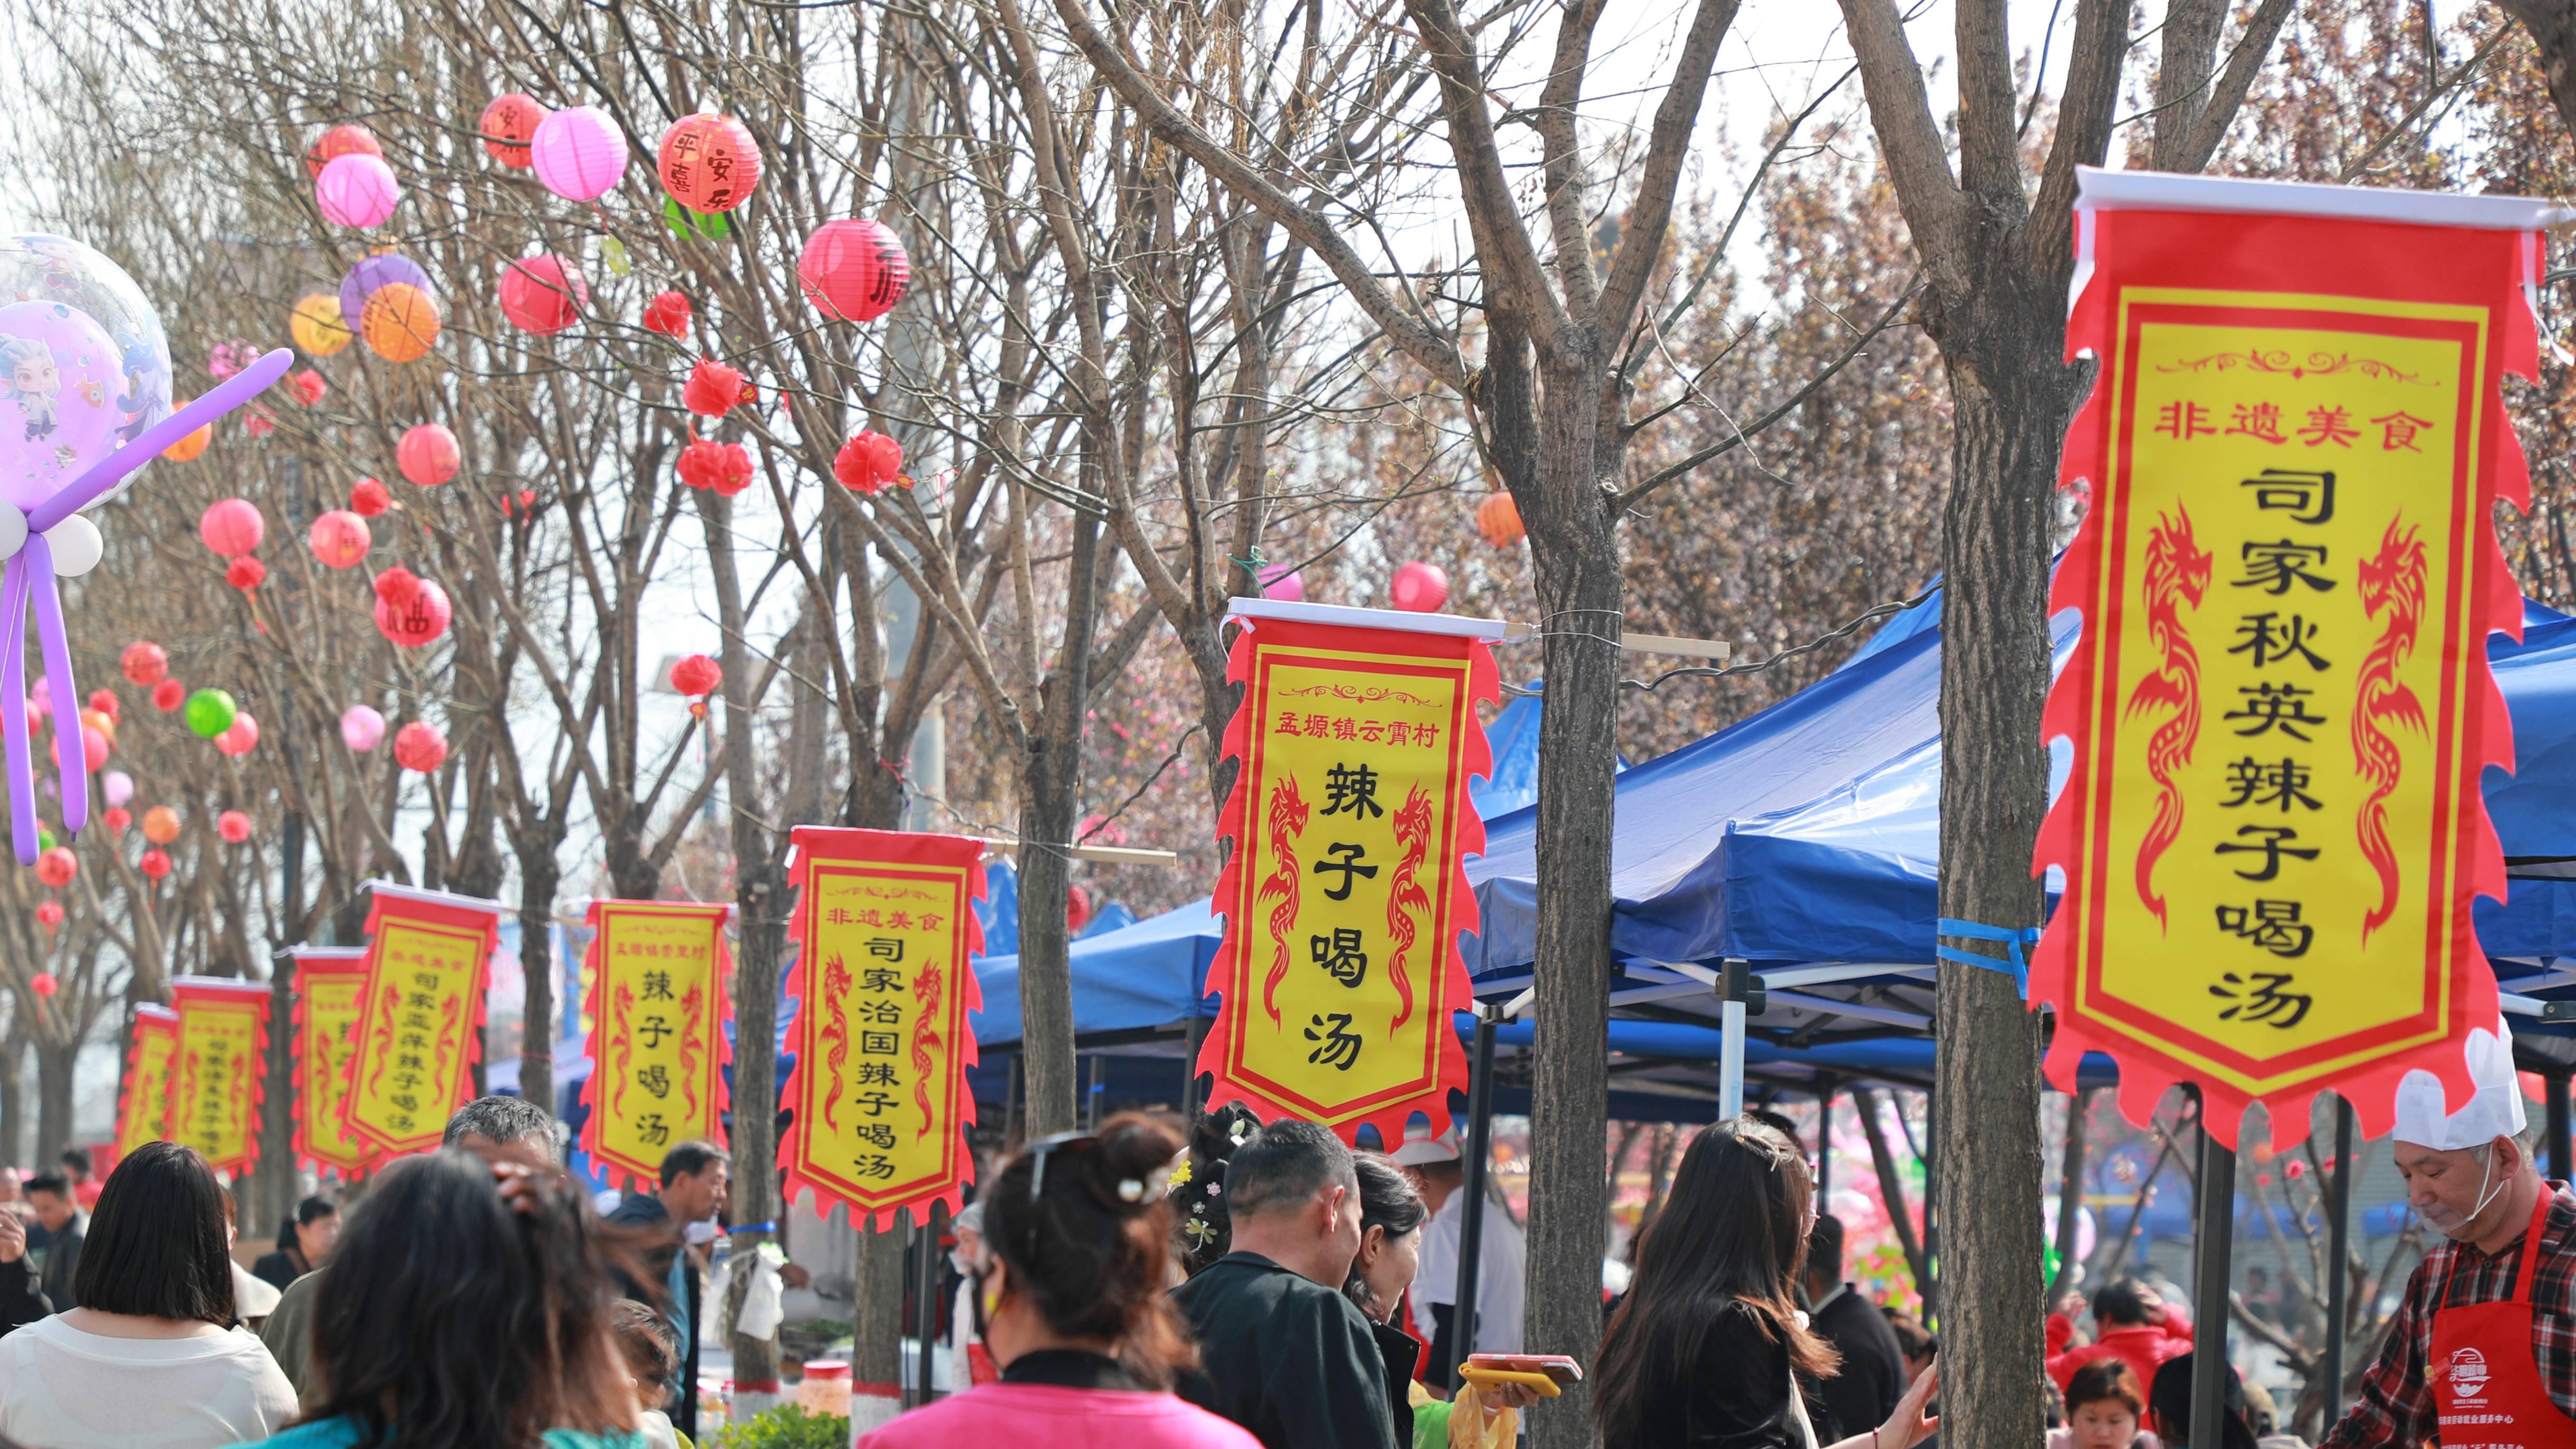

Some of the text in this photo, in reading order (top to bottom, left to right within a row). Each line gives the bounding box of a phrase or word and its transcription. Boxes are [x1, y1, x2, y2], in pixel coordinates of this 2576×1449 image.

[2155, 400, 2435, 453] 非遗美食
[1274, 711, 1441, 749] 孟塬镇云霄村
[2208, 468, 2338, 1029] 司家秋英辣子喝汤
[825, 907, 946, 933] 非遗美食
[1303, 762, 1384, 1072] 辣子喝汤
[636, 970, 674, 1146] 辣子喝汤
[853, 937, 905, 1181] 司家治国辣子喝汤
